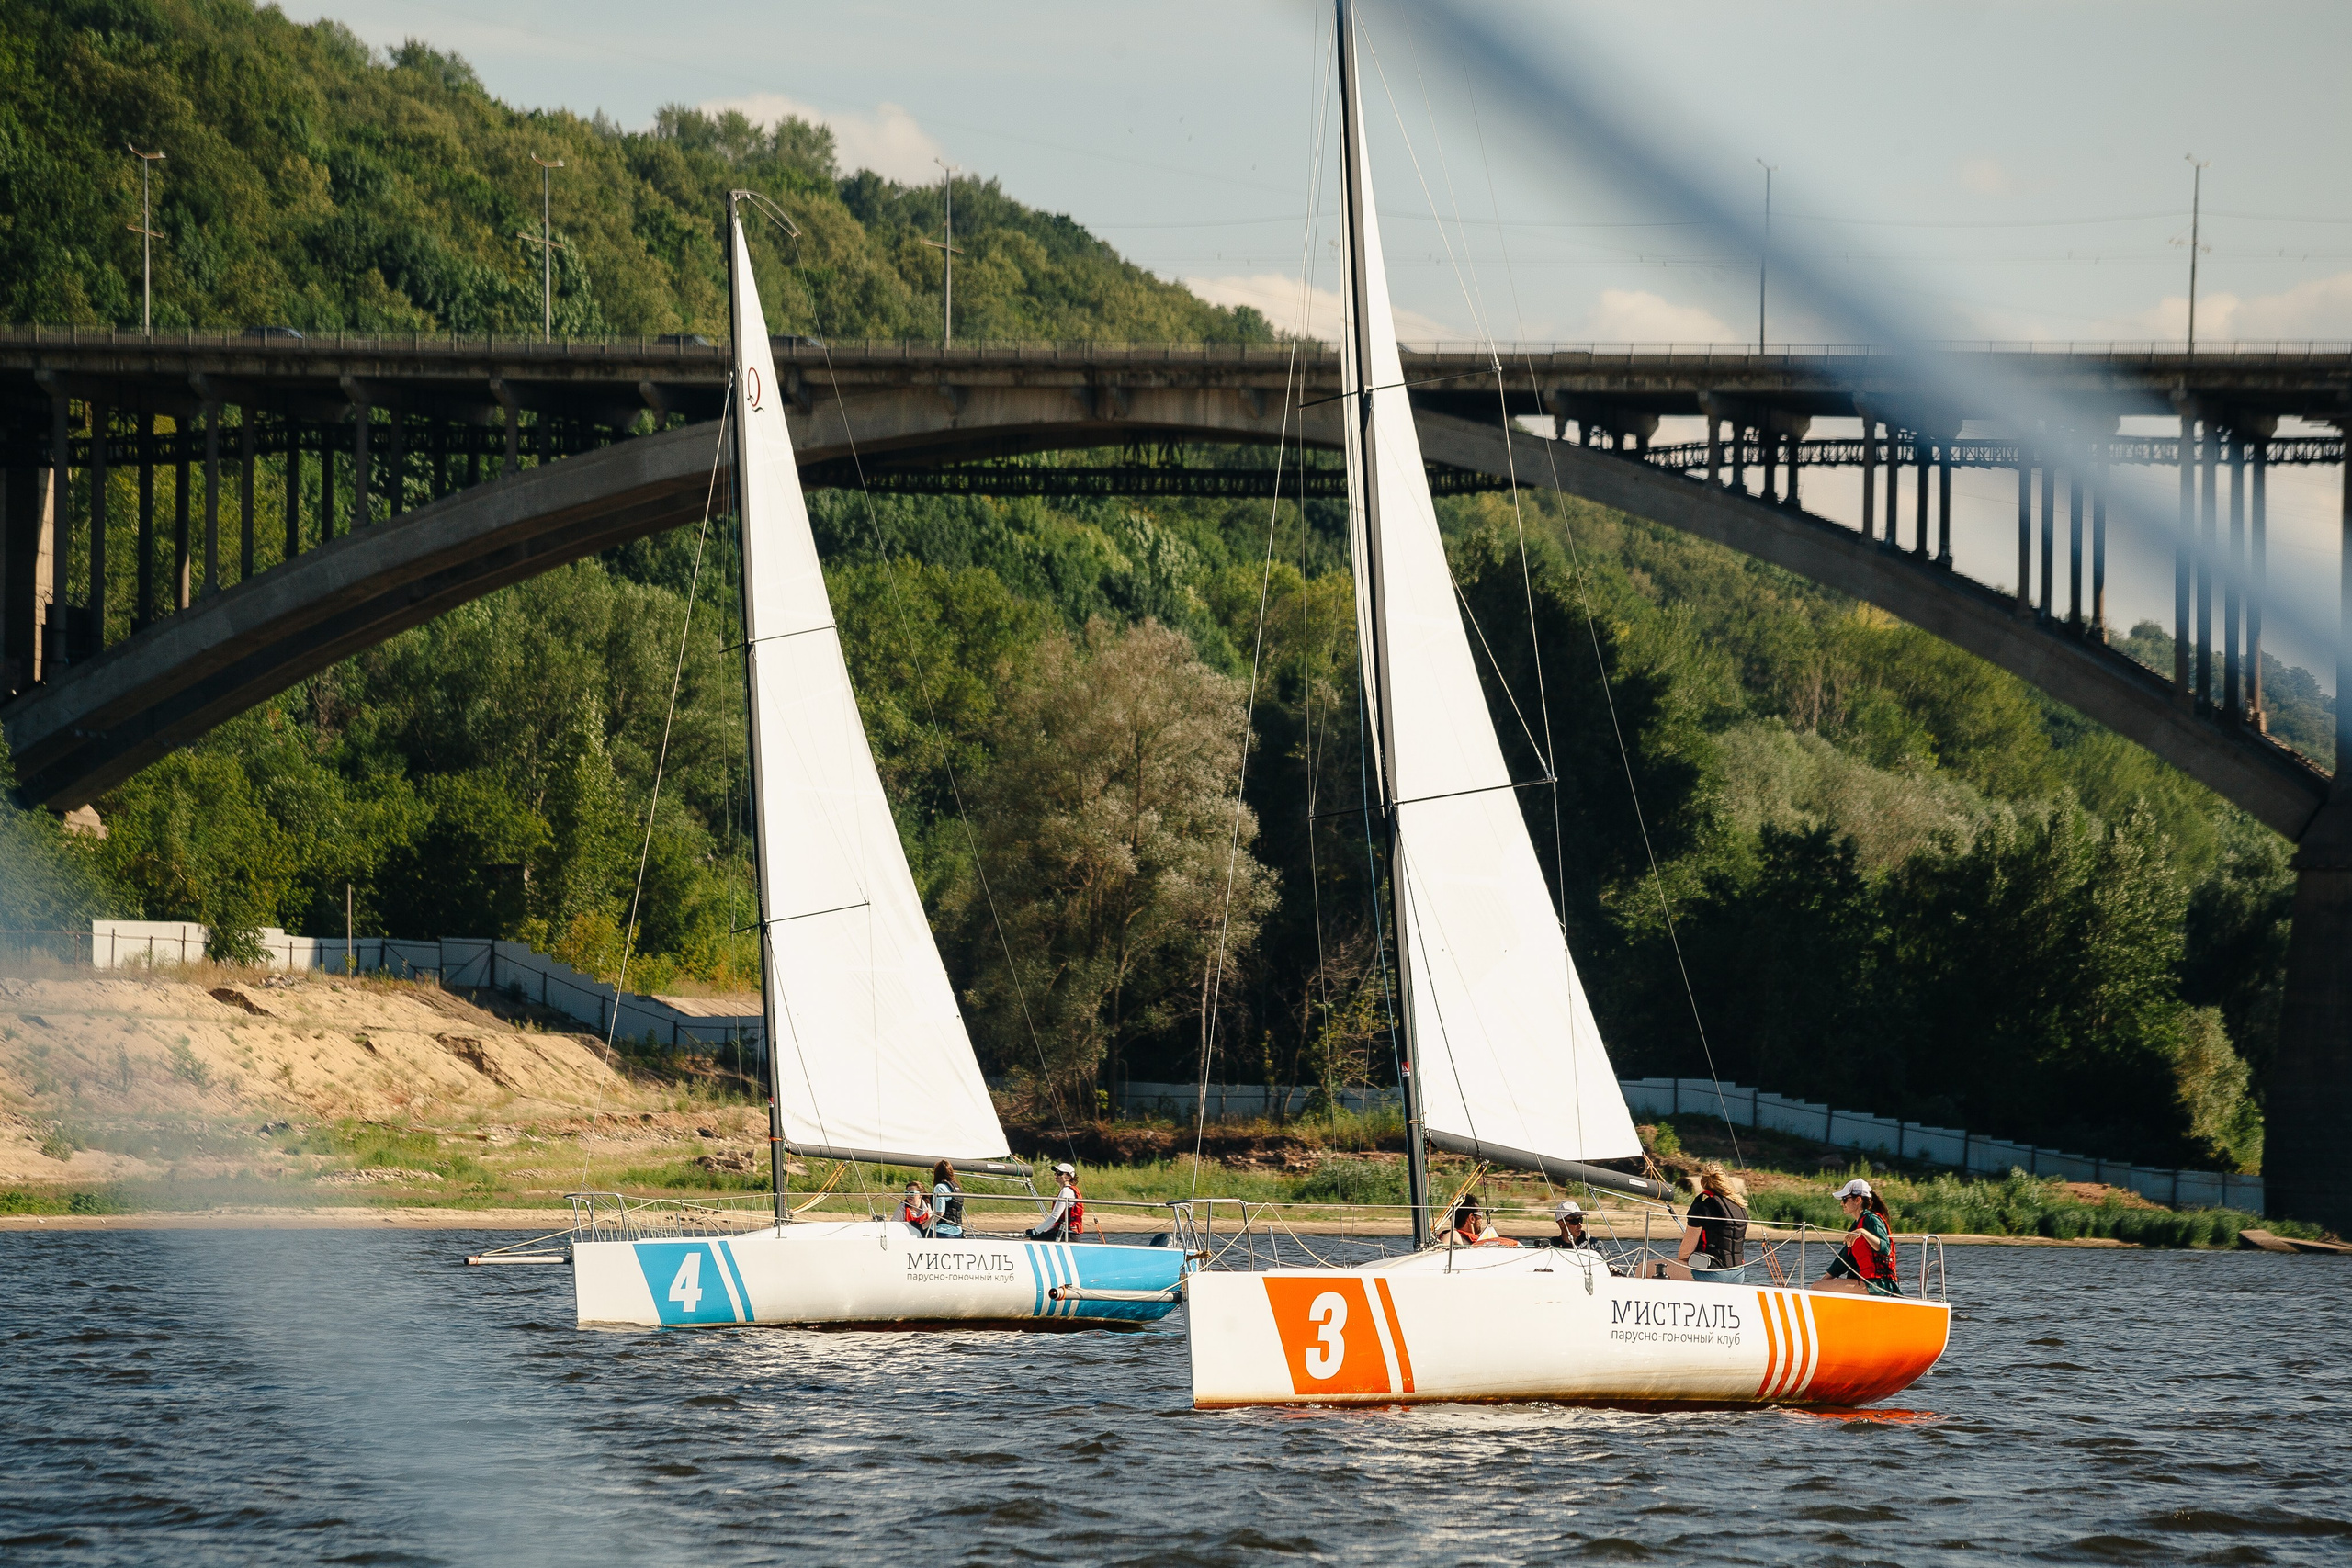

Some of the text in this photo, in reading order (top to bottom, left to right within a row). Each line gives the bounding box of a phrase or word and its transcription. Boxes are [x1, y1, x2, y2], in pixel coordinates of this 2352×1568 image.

[906, 1252, 1014, 1271] МИСТРАЛЬ
[669, 1252, 703, 1313] 4
[907, 1273, 1015, 1283] парусно-гоночный клуб
[1611, 1299, 1741, 1329] МИСТРАЛЬ
[1305, 1291, 1348, 1380] 3
[1611, 1330, 1741, 1348] парусно-гоночный клуб
